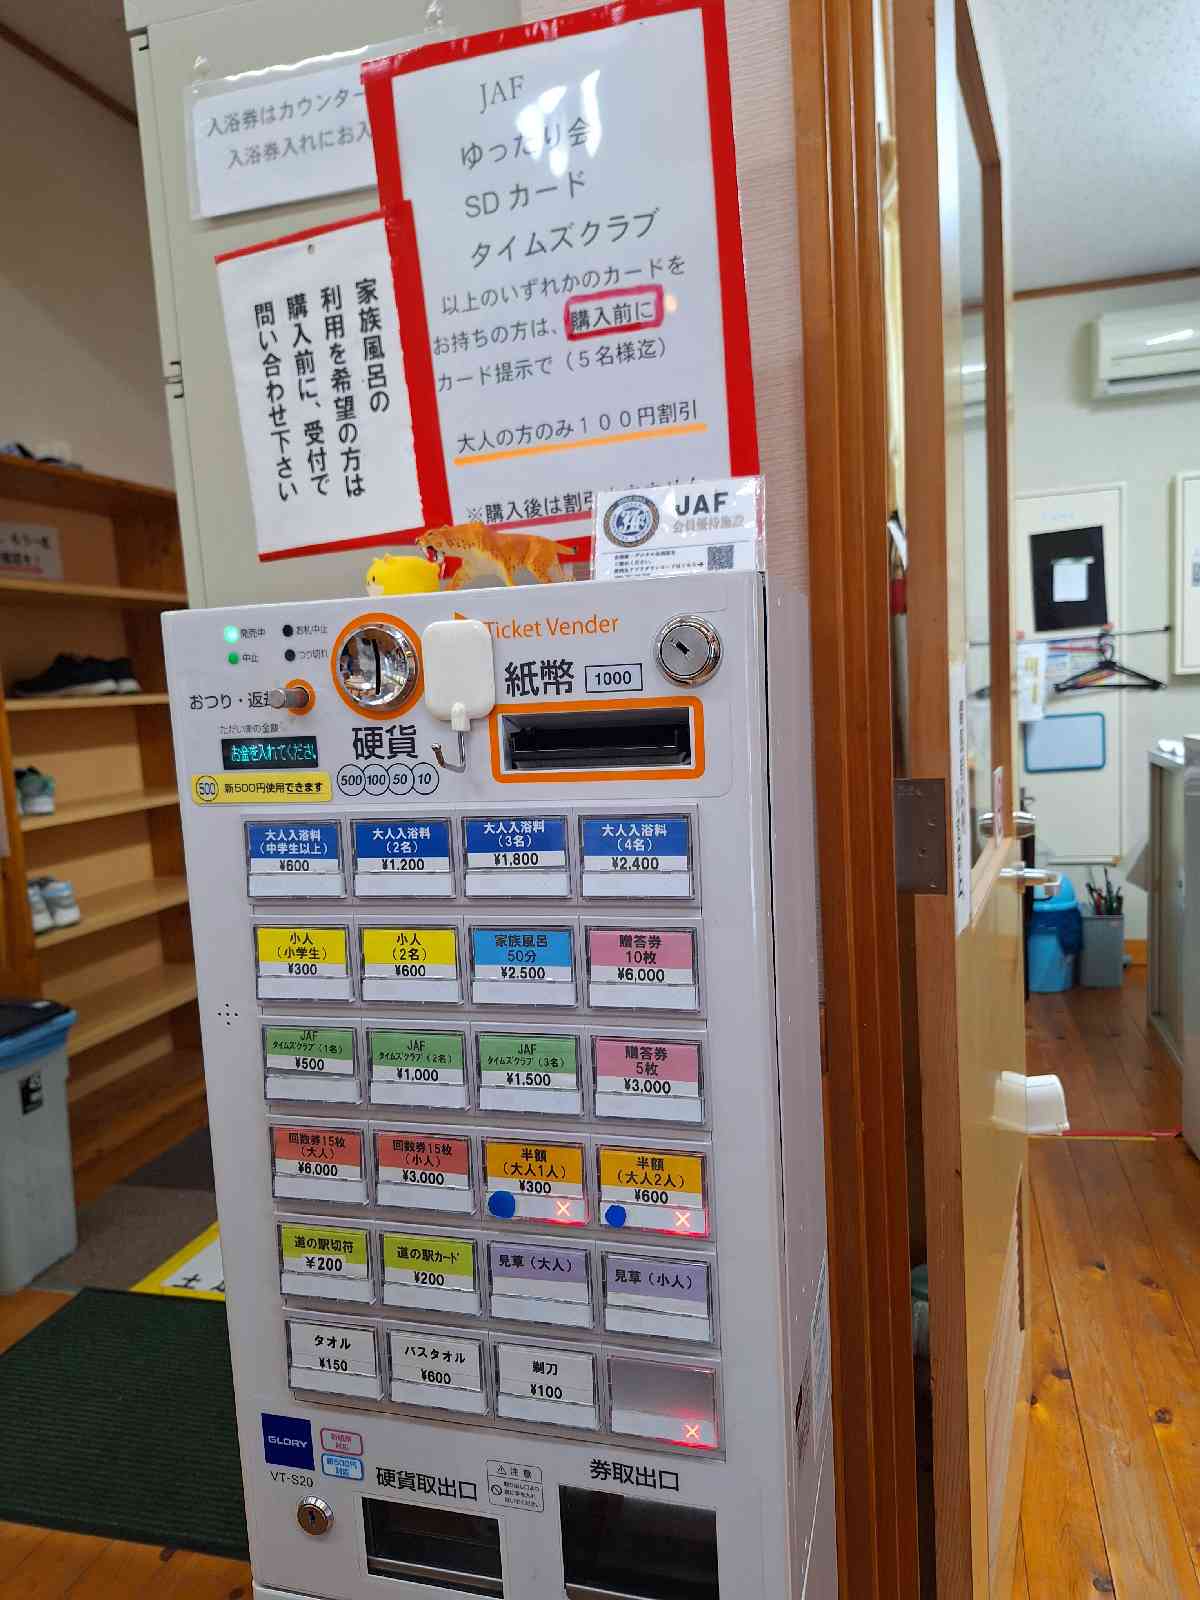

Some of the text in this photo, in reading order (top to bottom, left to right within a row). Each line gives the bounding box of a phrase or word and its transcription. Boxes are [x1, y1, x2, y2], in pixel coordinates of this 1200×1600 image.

[480, 75, 524, 114] JAF
[471, 208, 660, 268] タイムズクラブ
[440, 255, 686, 314] 以上のいずれかのカードを
[356, 278, 390, 412] 家族風呂の
[287, 293, 329, 496] 購入前に、受付で
[321, 285, 365, 498] 利用を希望の方は
[255, 302, 298, 501] 問い合わせ下さい
[675, 492, 728, 515] JAF
[485, 615, 621, 640] Ticket Vender
[504, 659, 574, 697] 紙幣
[594, 670, 632, 686] 1000
[352, 725, 418, 760] 硬貨
[341, 772, 432, 786] 500 100 50 10
[224, 782, 324, 795] 新500円使用できます
[372, 827, 432, 840] 大人入浴料
[484, 820, 545, 833] 大人入浴料
[602, 823, 667, 837] 大人入浴料
[264, 829, 321, 842] 大人入浴料
[279, 860, 310, 872] ¥600
[290, 932, 314, 945] 小人
[396, 933, 422, 946] 小人
[507, 951, 537, 963] 50分
[625, 951, 657, 965] 10枚
[288, 963, 318, 976] ¥300
[395, 965, 426, 977] ¥600
[407, 1040, 426, 1051] JAF
[517, 1043, 537, 1055] JAF
[295, 1056, 325, 1071] ¥500
[636, 1062, 659, 1076] 5枚
[521, 1148, 548, 1162] 半額
[637, 1157, 665, 1172] 半額
[519, 1180, 552, 1194] ¥300
[634, 1189, 669, 1204] ¥600
[294, 1235, 354, 1254] 道の駅切符
[305, 1255, 343, 1272] ¥200
[414, 1271, 445, 1286] ¥200
[314, 1334, 351, 1350] タオル
[404, 1346, 466, 1364] バスタオル
[319, 1357, 348, 1372] ¥150
[420, 1368, 451, 1384] ¥600
[530, 1383, 563, 1400] ¥100
[268, 1435, 308, 1448] GLORY
[270, 1471, 315, 1488] VT-S20
[590, 1458, 680, 1492] 券取出口
[375, 1466, 478, 1501] 硬貨取出口
